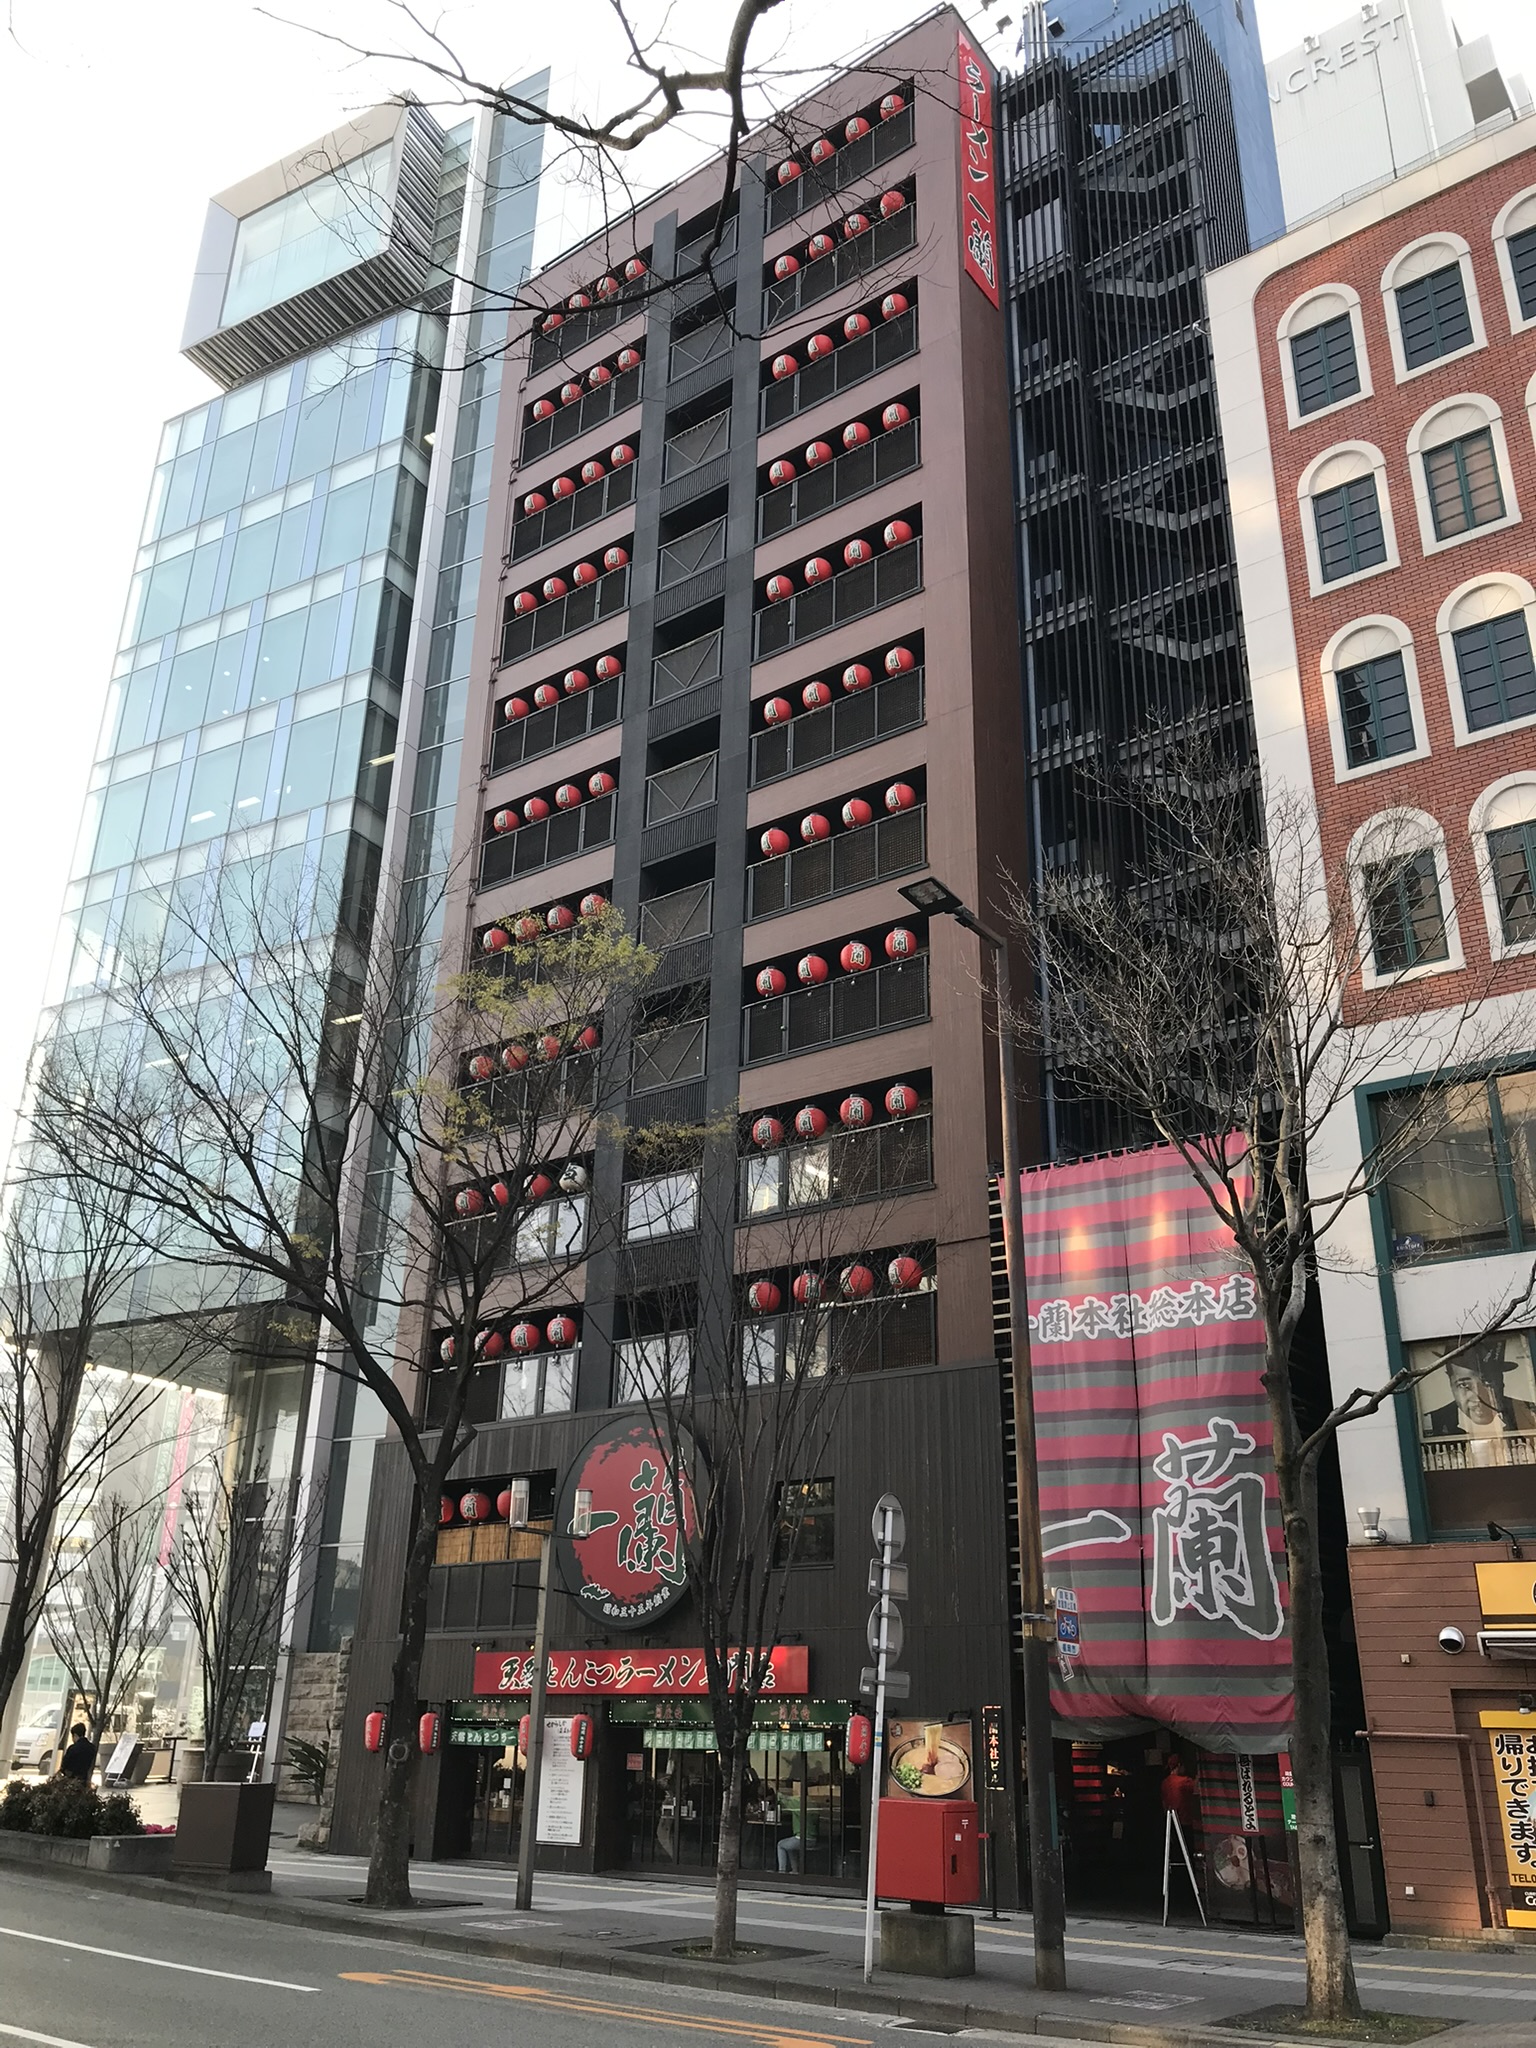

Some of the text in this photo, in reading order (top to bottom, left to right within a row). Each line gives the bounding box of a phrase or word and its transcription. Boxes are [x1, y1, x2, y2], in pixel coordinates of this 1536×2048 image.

[1029, 1273, 1257, 1344] 蘭本社総本店
[1042, 1416, 1284, 1641] 一蘭
